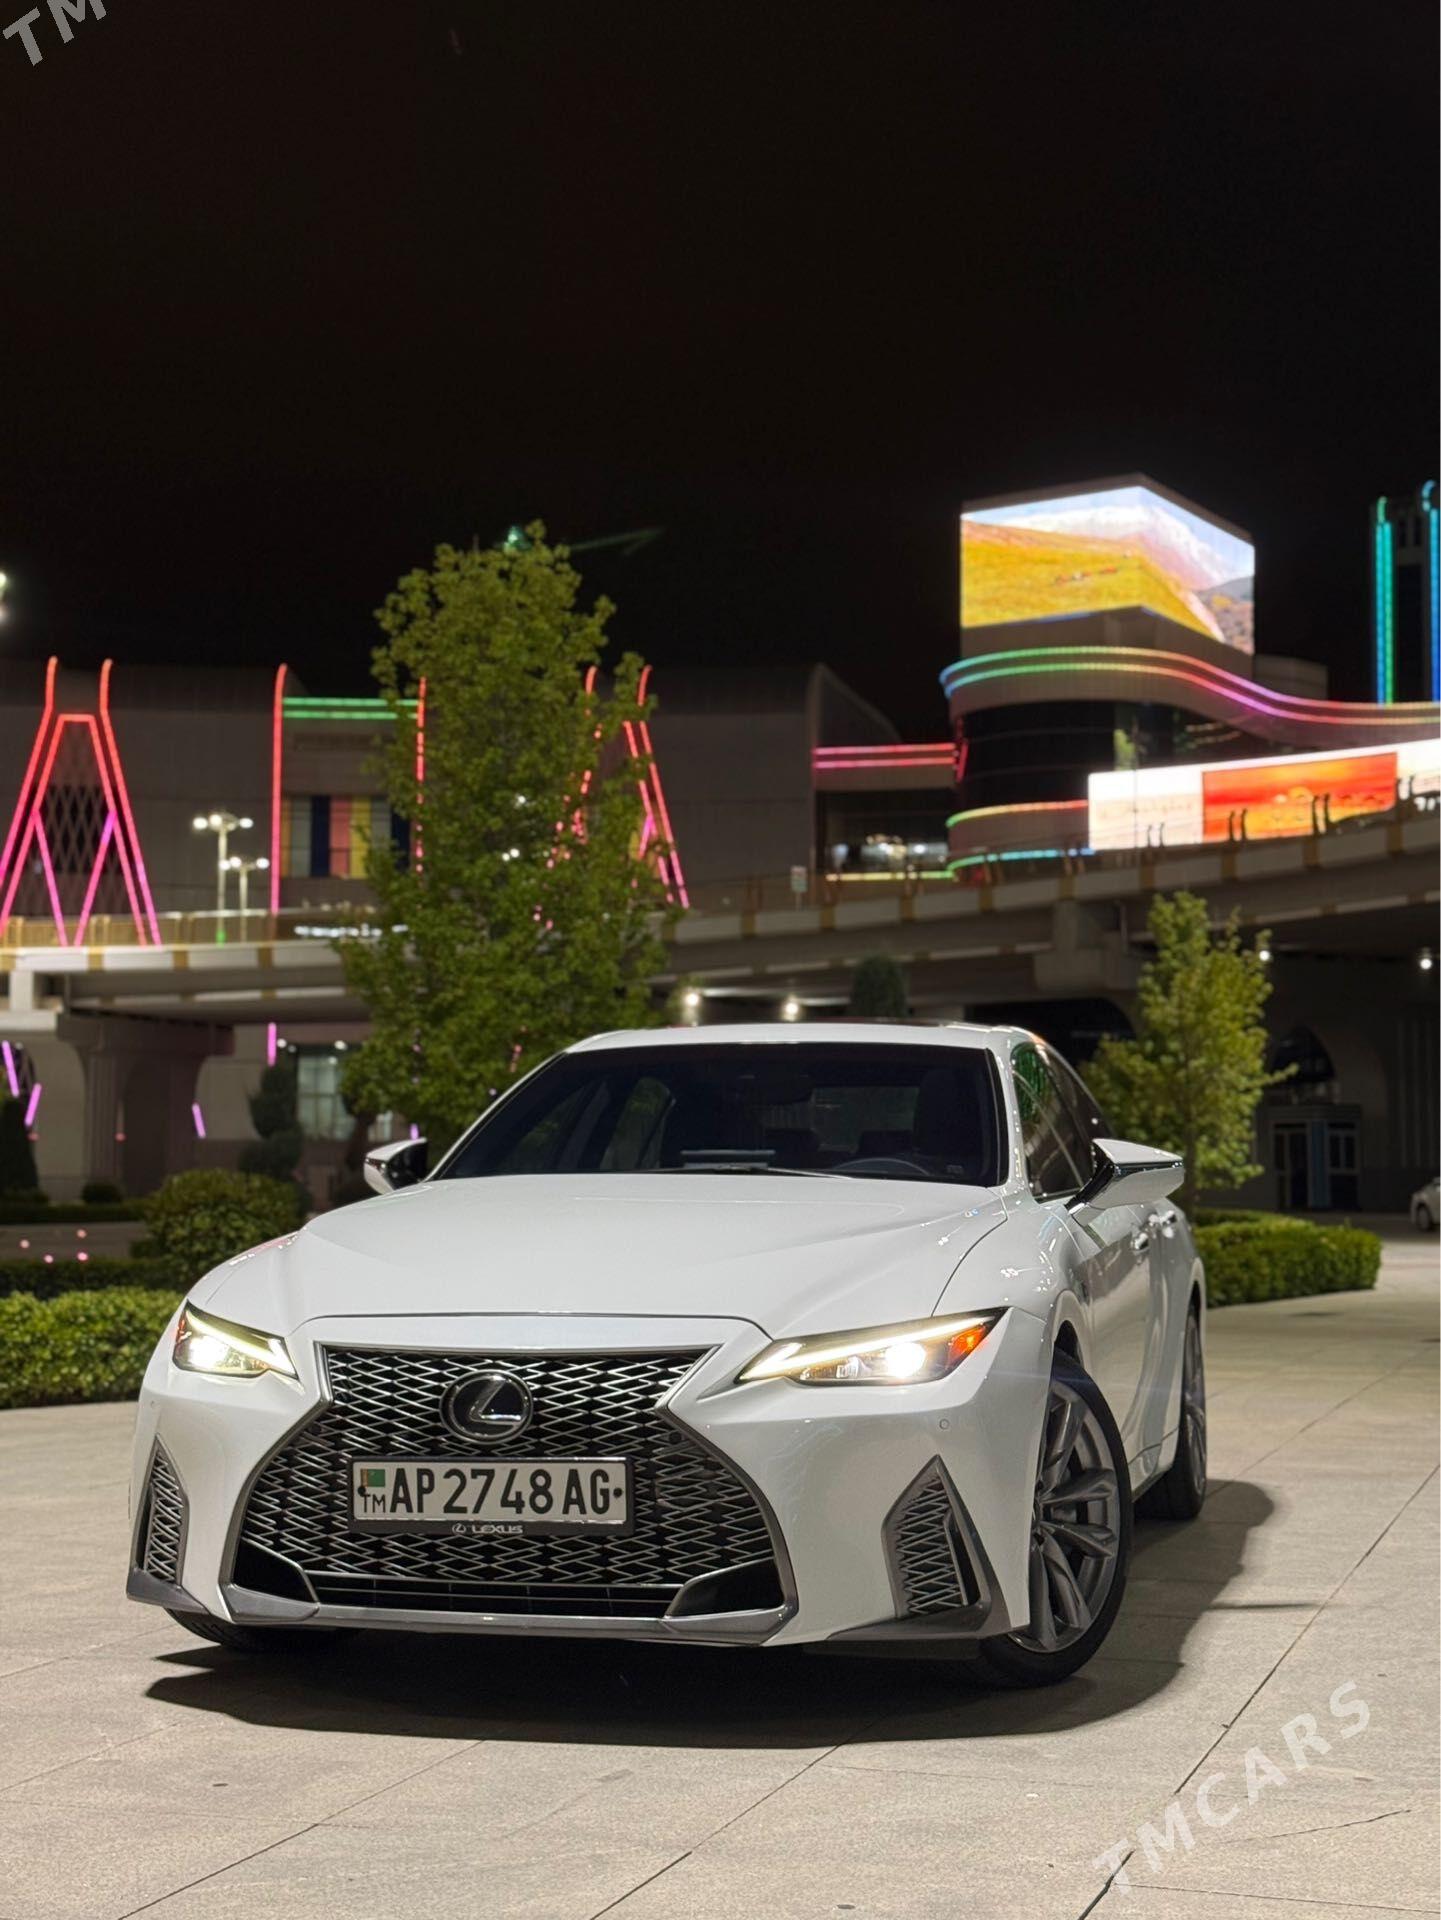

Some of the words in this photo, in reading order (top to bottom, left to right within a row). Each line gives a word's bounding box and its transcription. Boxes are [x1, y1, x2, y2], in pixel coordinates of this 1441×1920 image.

[389, 1467, 435, 1513] AP
[442, 1468, 554, 1514] 2748
[562, 1468, 610, 1515] AG
[361, 1493, 386, 1513] TM
[471, 1524, 524, 1534] LEXUS
